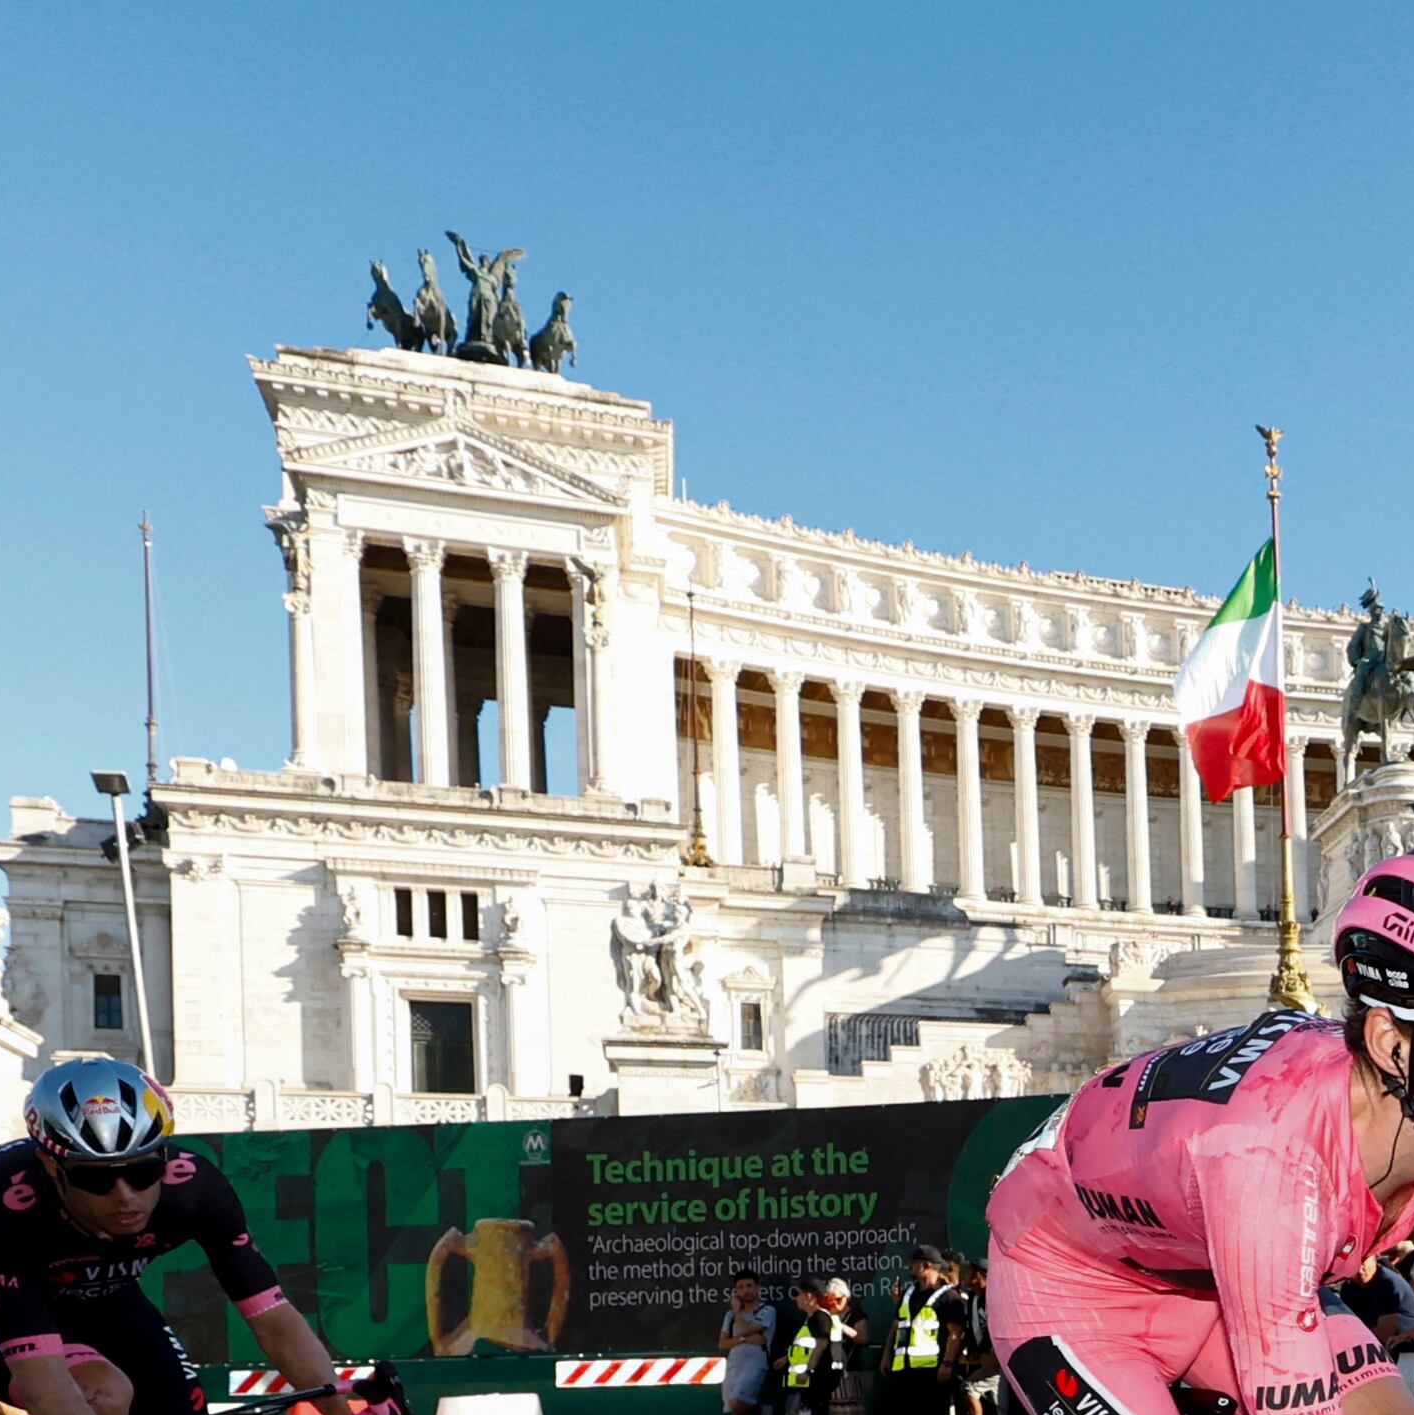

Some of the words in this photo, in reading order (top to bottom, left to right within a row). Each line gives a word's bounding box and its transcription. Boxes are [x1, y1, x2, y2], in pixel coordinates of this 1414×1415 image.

[586, 1149, 763, 1189] Technique
[771, 1147, 805, 1177] at
[812, 1142, 870, 1176] the
[587, 1190, 707, 1226] service
[714, 1187, 751, 1222] of
[757, 1187, 879, 1225] history
[728, 1228, 820, 1253] top-down
[587, 1260, 619, 1282] the
[622, 1257, 696, 1280] method
[699, 1256, 724, 1278] for
[728, 1253, 803, 1280] building
[806, 1252, 838, 1273] the
[589, 1285, 684, 1312] preserving
[687, 1283, 719, 1304] the
